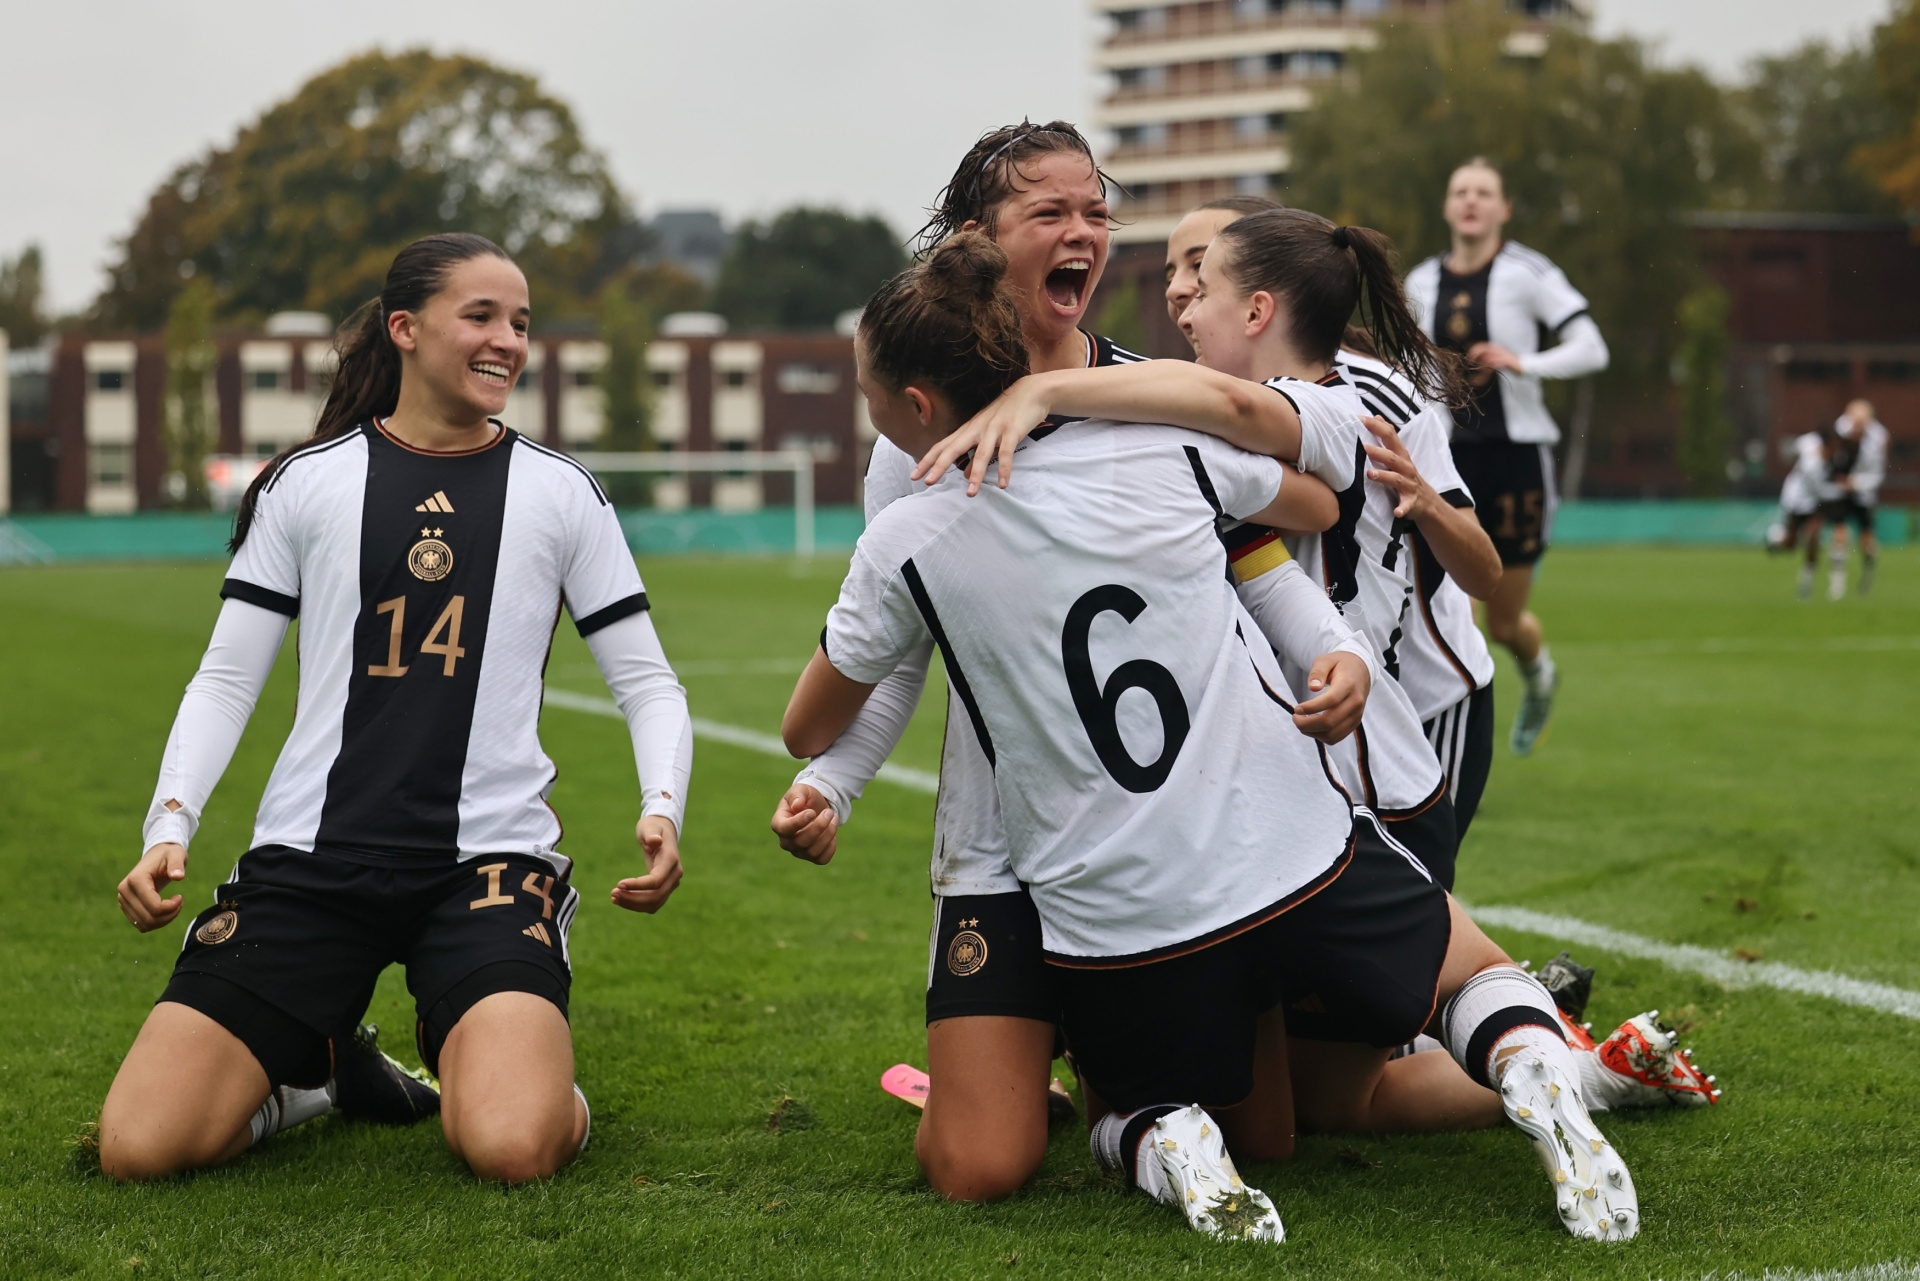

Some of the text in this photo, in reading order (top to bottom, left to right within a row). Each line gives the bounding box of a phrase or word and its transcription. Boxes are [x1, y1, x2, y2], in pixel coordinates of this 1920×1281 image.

[367, 594, 466, 678] 14
[1061, 583, 1191, 794] 6
[469, 862, 555, 920] 14
